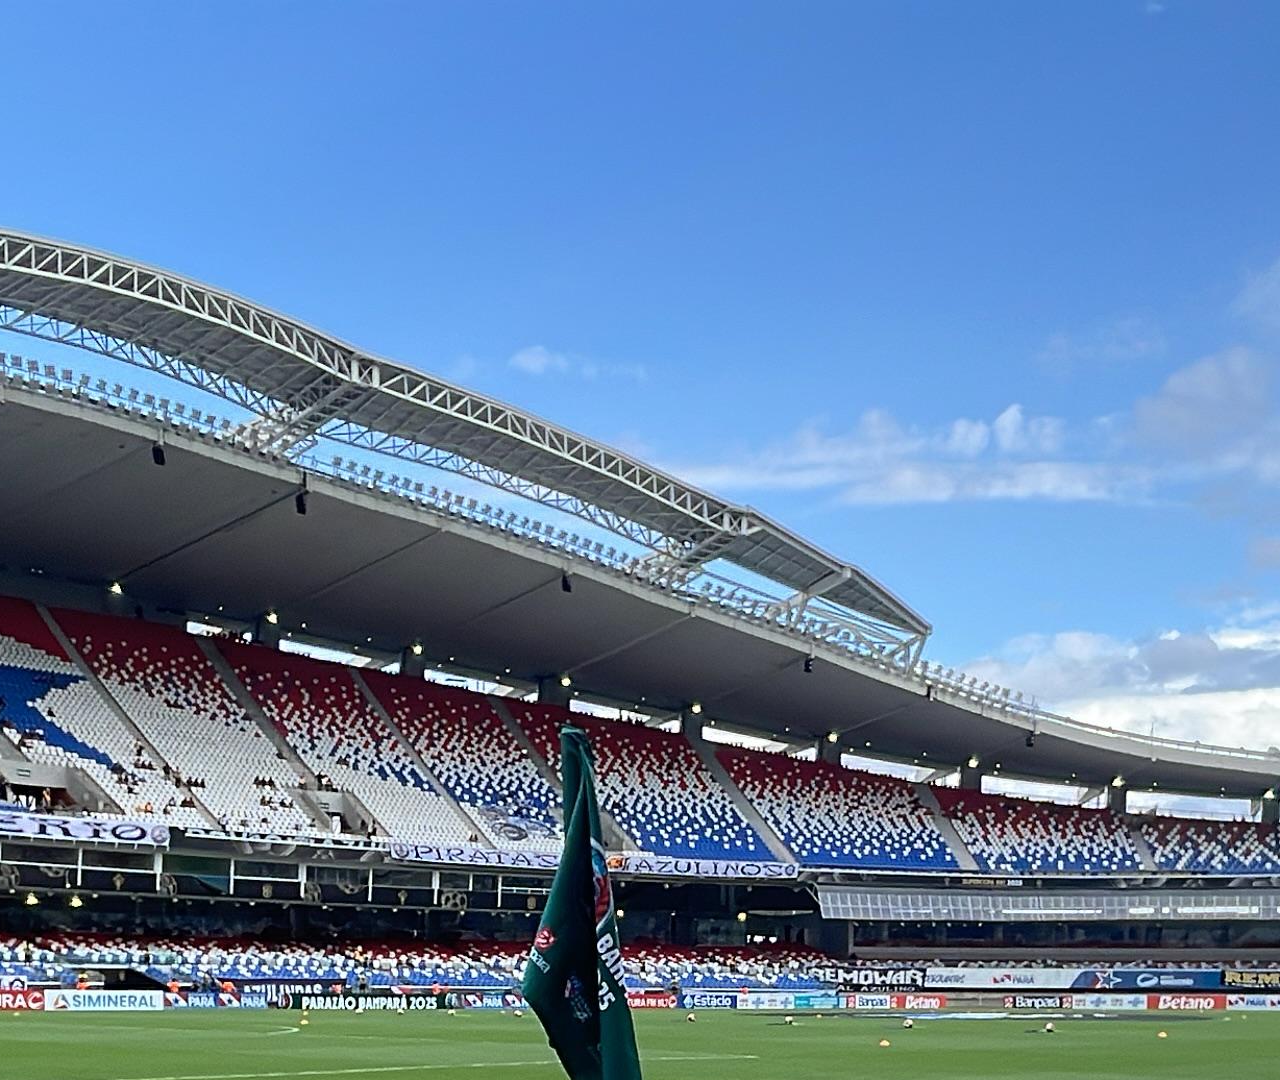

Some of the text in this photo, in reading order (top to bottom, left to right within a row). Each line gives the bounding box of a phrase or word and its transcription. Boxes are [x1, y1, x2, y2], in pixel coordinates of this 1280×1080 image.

[634, 858, 782, 877] AZULINOS
[73, 994, 158, 1008] SIMINERAL
[1158, 996, 1215, 1010] Betano
